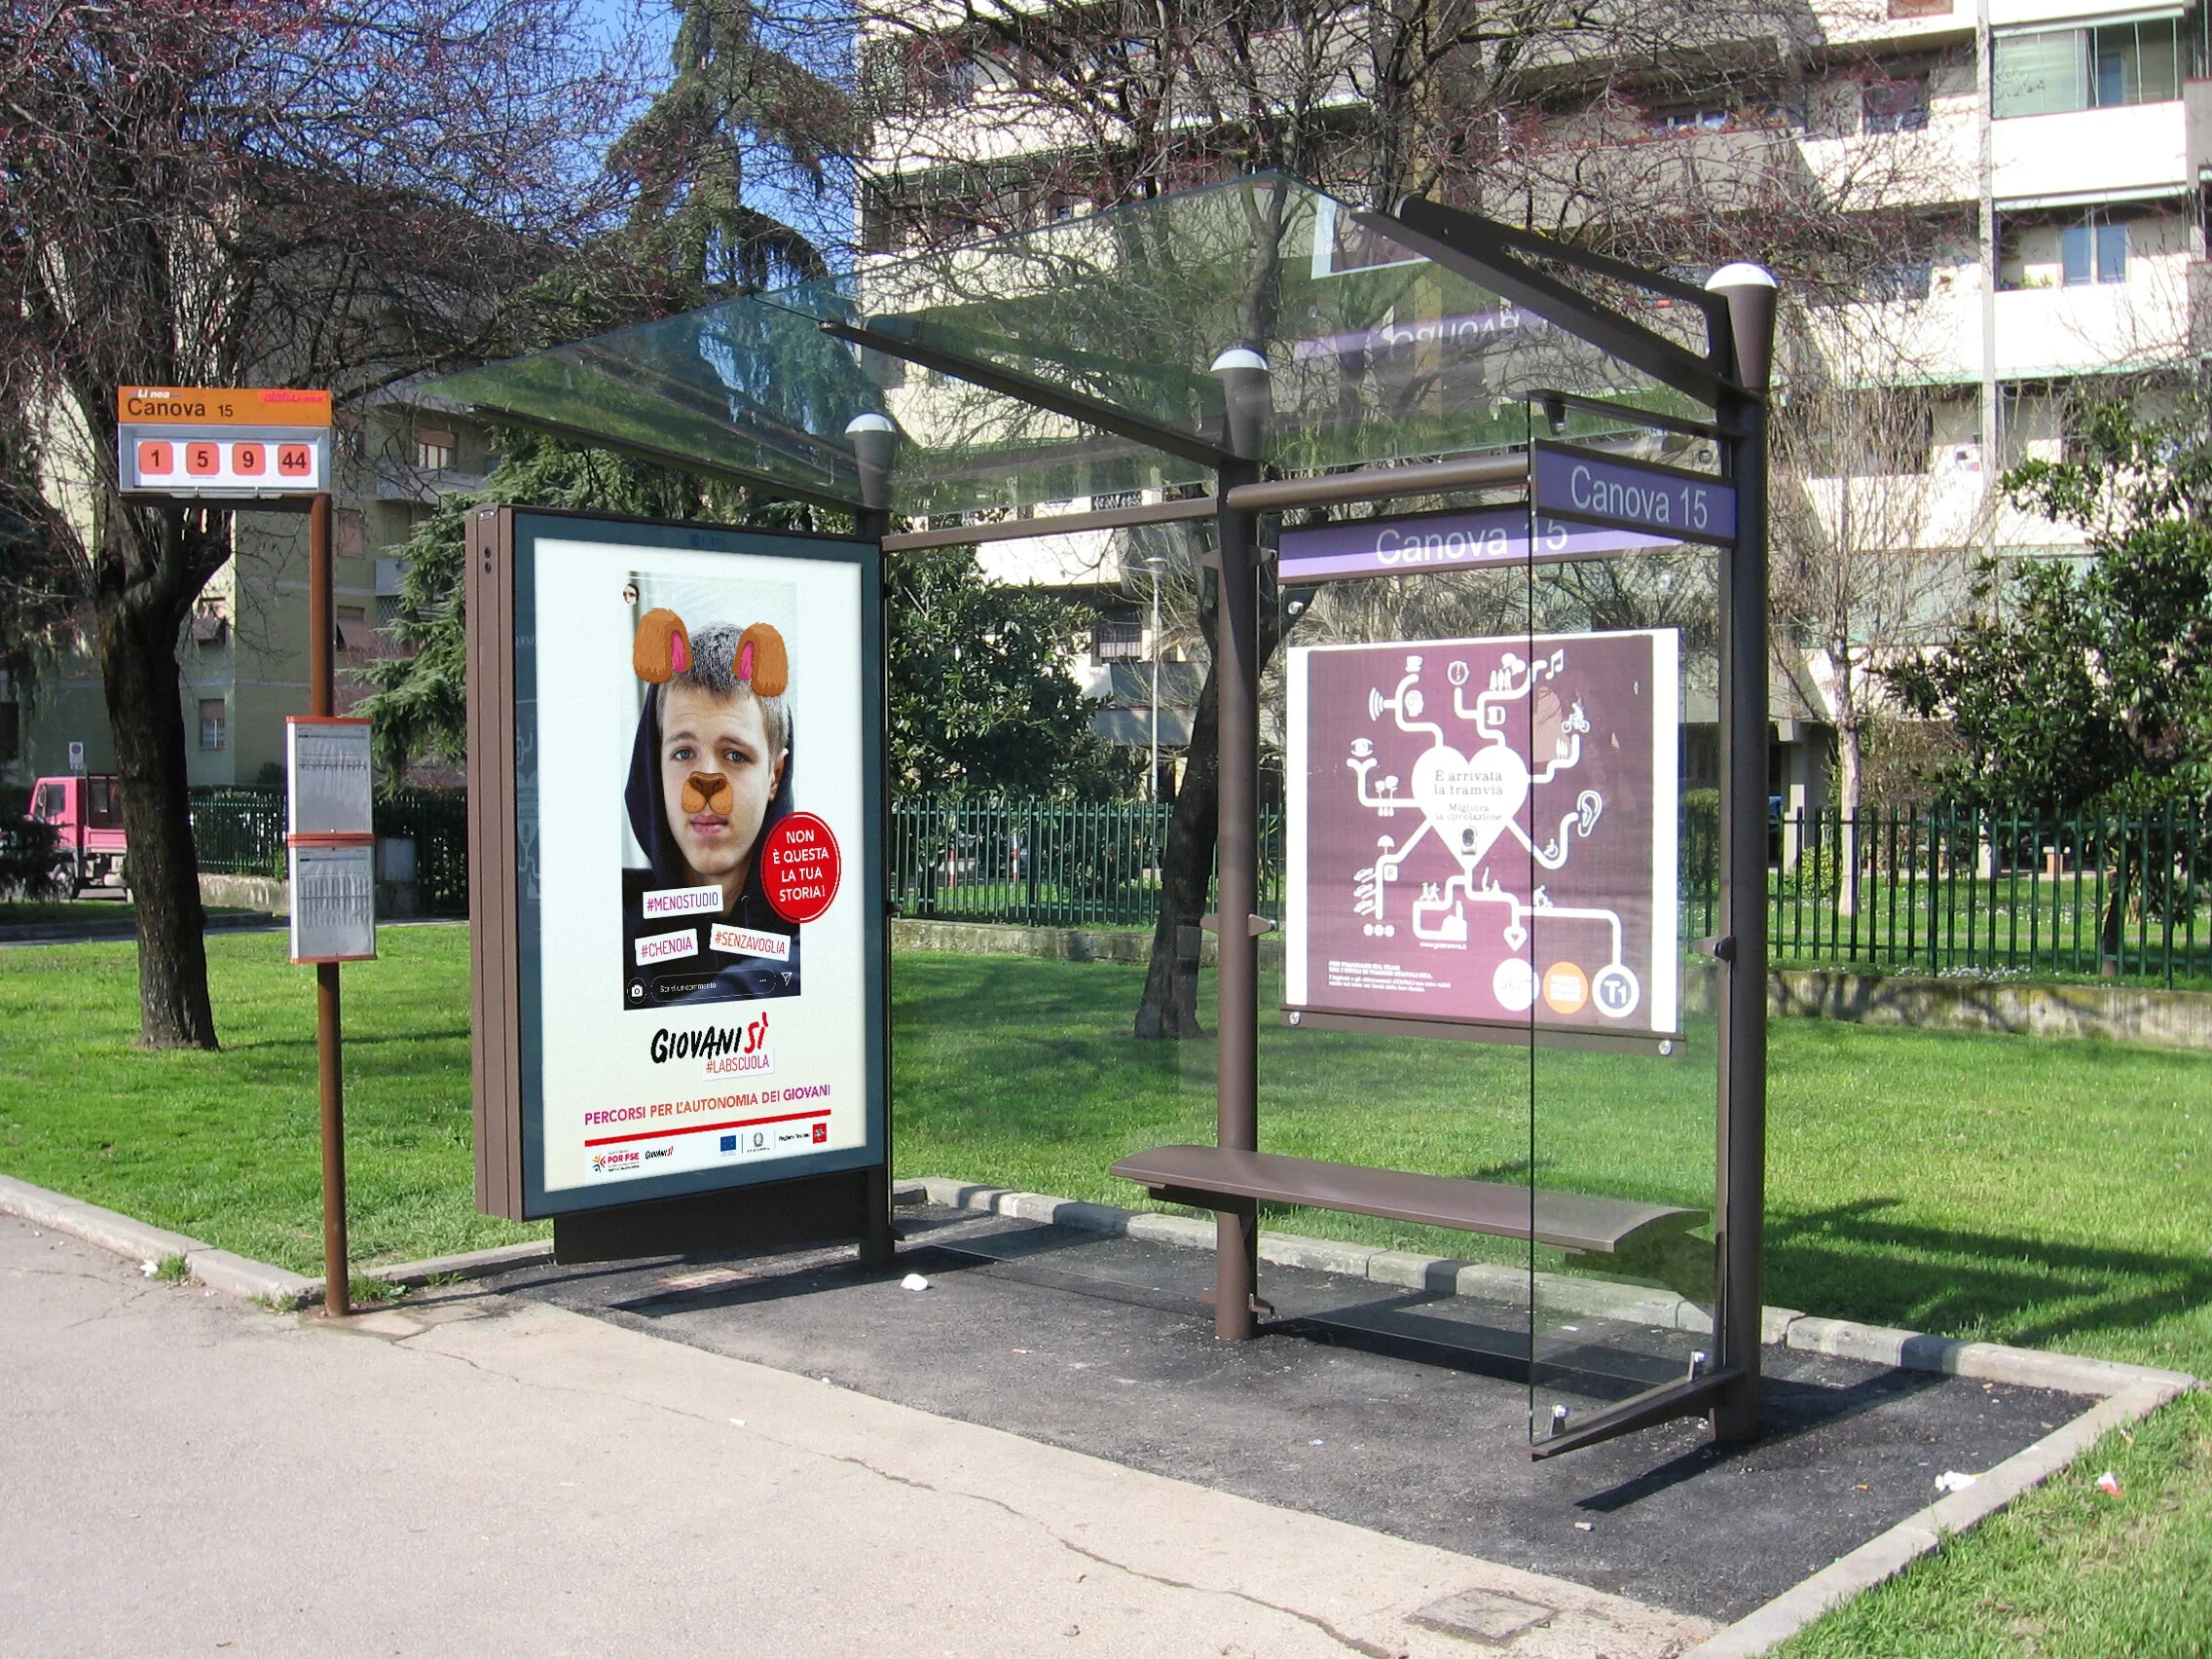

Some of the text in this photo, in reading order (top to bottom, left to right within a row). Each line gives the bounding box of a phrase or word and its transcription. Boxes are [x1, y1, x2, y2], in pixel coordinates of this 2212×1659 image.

[128, 398, 234, 418] Canova 15
[151, 450, 160, 466] 1
[197, 451, 208, 467] 5
[242, 451, 254, 467] 9
[281, 451, 307, 469] 44
[1569, 464, 1708, 531] Canova 15
[1375, 519, 1568, 565] Canova 15
[1449, 771, 1502, 781] arrivata
[1434, 784, 1503, 795] la tramvia
[786, 830, 815, 844] NON
[772, 847, 830, 865] È QUESTA
[781, 866, 823, 883] LA TUA
[645, 892, 719, 912] #MENOSTUDIO
[779, 887, 826, 903] STORIA!
[641, 936, 693, 959] #CHENOIA
[714, 931, 786, 955] #SENZAVOGLIA
[1604, 979, 1627, 1005] T1
[705, 1054, 770, 1074] #LABSCUOLA
[584, 1084, 830, 1125] PERCORSI PER L'AUTONOMIA DEI GIOVANI
[608, 1155, 623, 1163] POR
[625, 1152, 640, 1161] FSE
